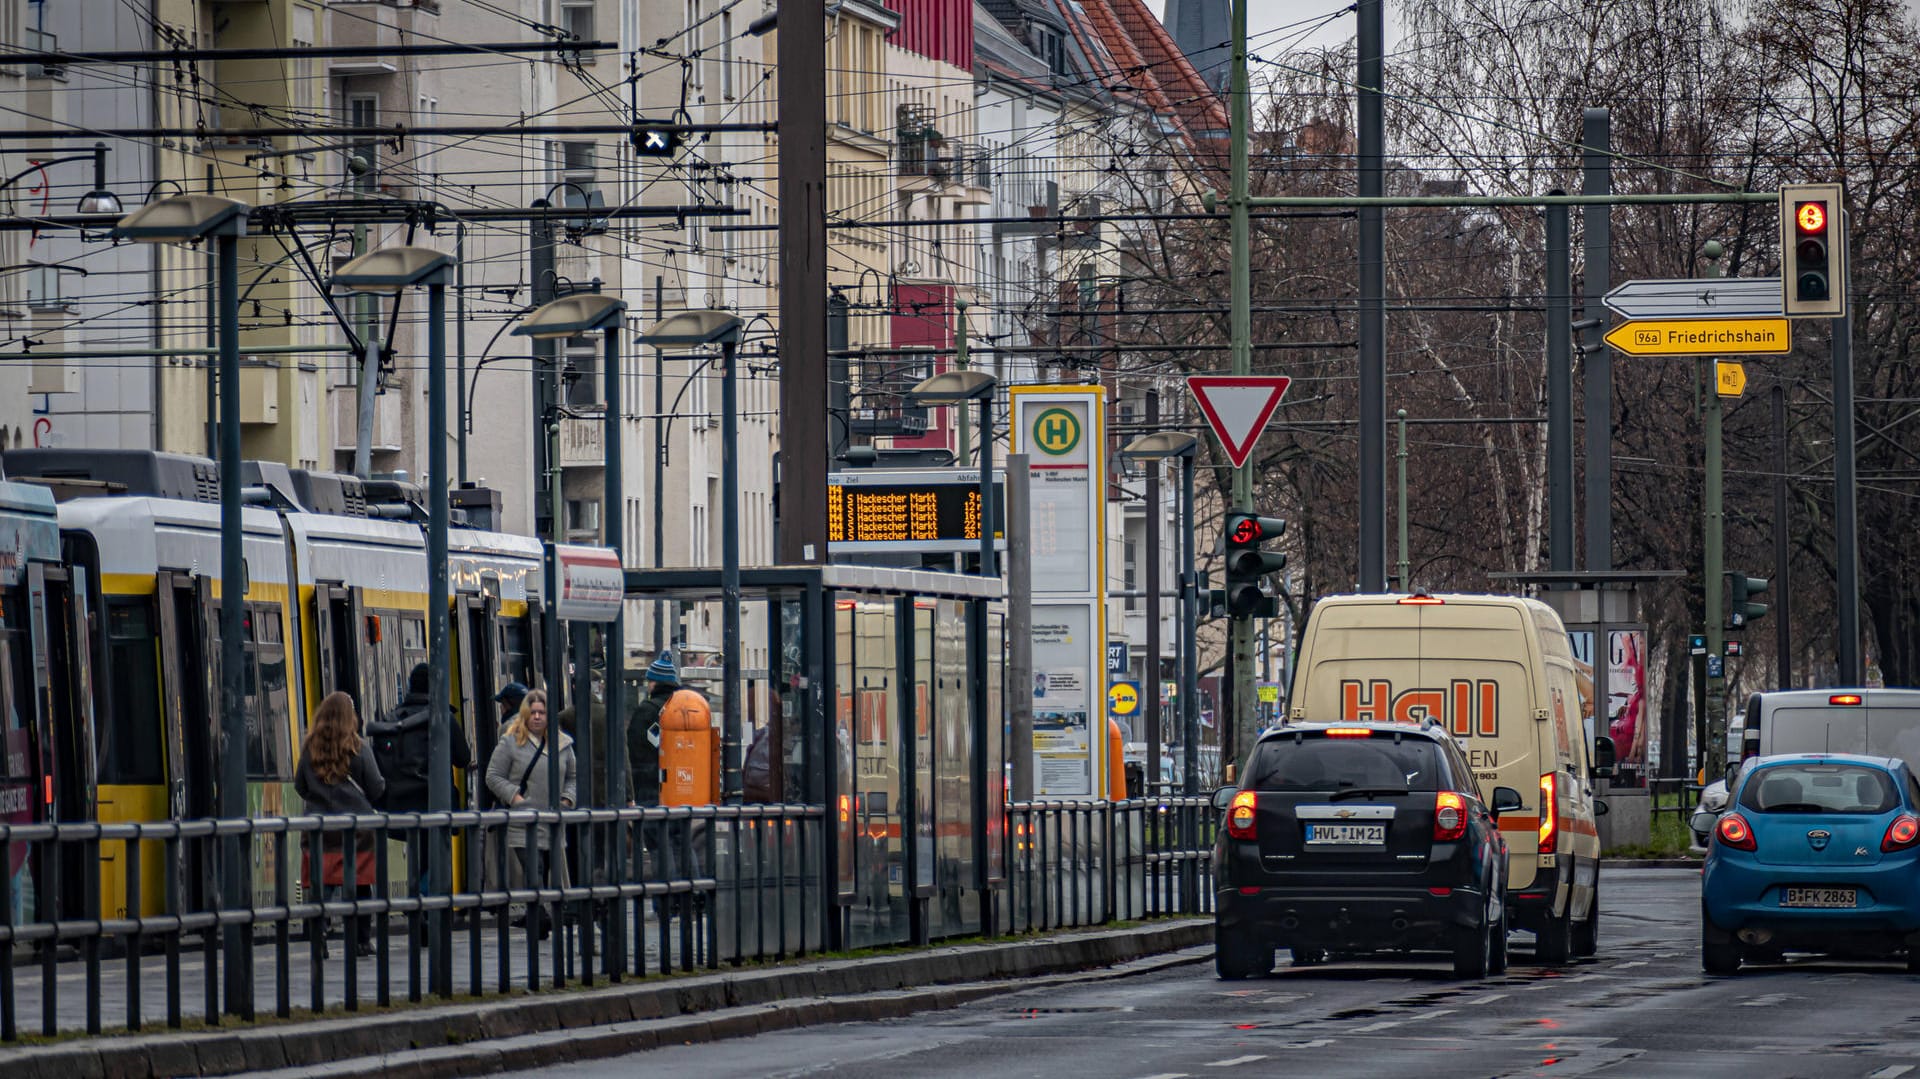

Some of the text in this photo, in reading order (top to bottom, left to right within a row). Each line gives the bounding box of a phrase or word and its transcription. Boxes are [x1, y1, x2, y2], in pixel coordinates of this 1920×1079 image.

[1638, 329, 1775, 343] 96a Friedrichshain
[846, 476, 859, 484] Ziel
[828, 485, 842, 494] M4
[829, 492, 976, 503] M4 S Hackescher Markt 9
[829, 501, 976, 512] M4 S Hackescher Markt 12
[829, 511, 976, 522] M4 S Hackescher Markt 16
[829, 520, 976, 531] M4 S Hackescher Markt 22
[829, 529, 976, 541] M4 S Hackescher Markt 26
[1470, 750, 1498, 768] EN
[1313, 827, 1339, 840] HVL
[1367, 827, 1383, 840] 21
[1788, 890, 1855, 903] B FK 2863
